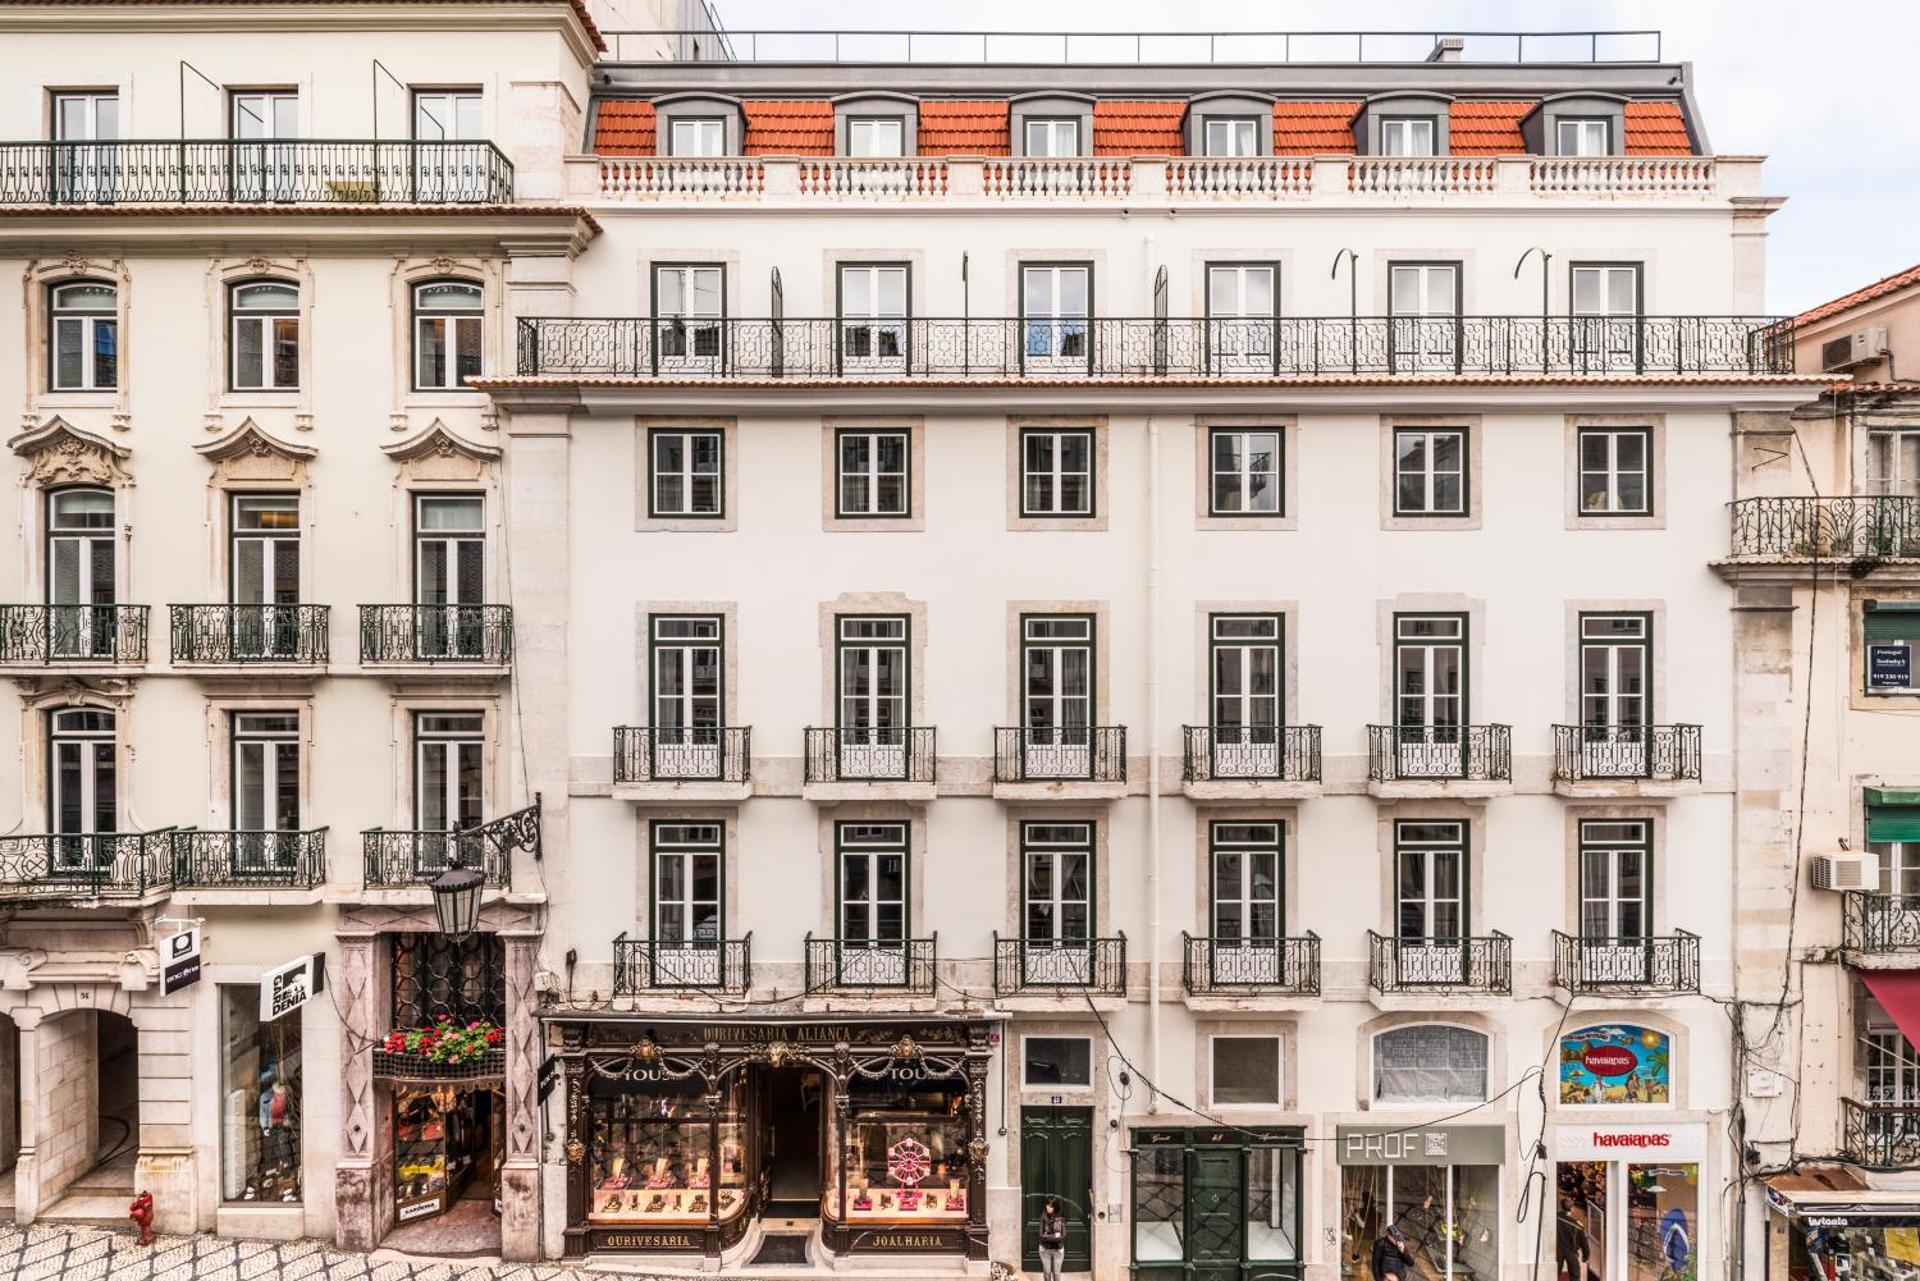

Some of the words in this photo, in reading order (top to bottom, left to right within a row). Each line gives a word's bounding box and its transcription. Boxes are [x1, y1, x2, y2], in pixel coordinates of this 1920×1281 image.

[704, 1026, 788, 1041] OURIVESARIA
[1585, 1056, 1630, 1066] havaianas
[625, 1069, 669, 1081] TOU
[1347, 1133, 1419, 1158] PROF
[1593, 1132, 1670, 1148] havaianas
[607, 1235, 690, 1246] OURIVESARIA
[872, 1235, 943, 1246] JOALHARIA
